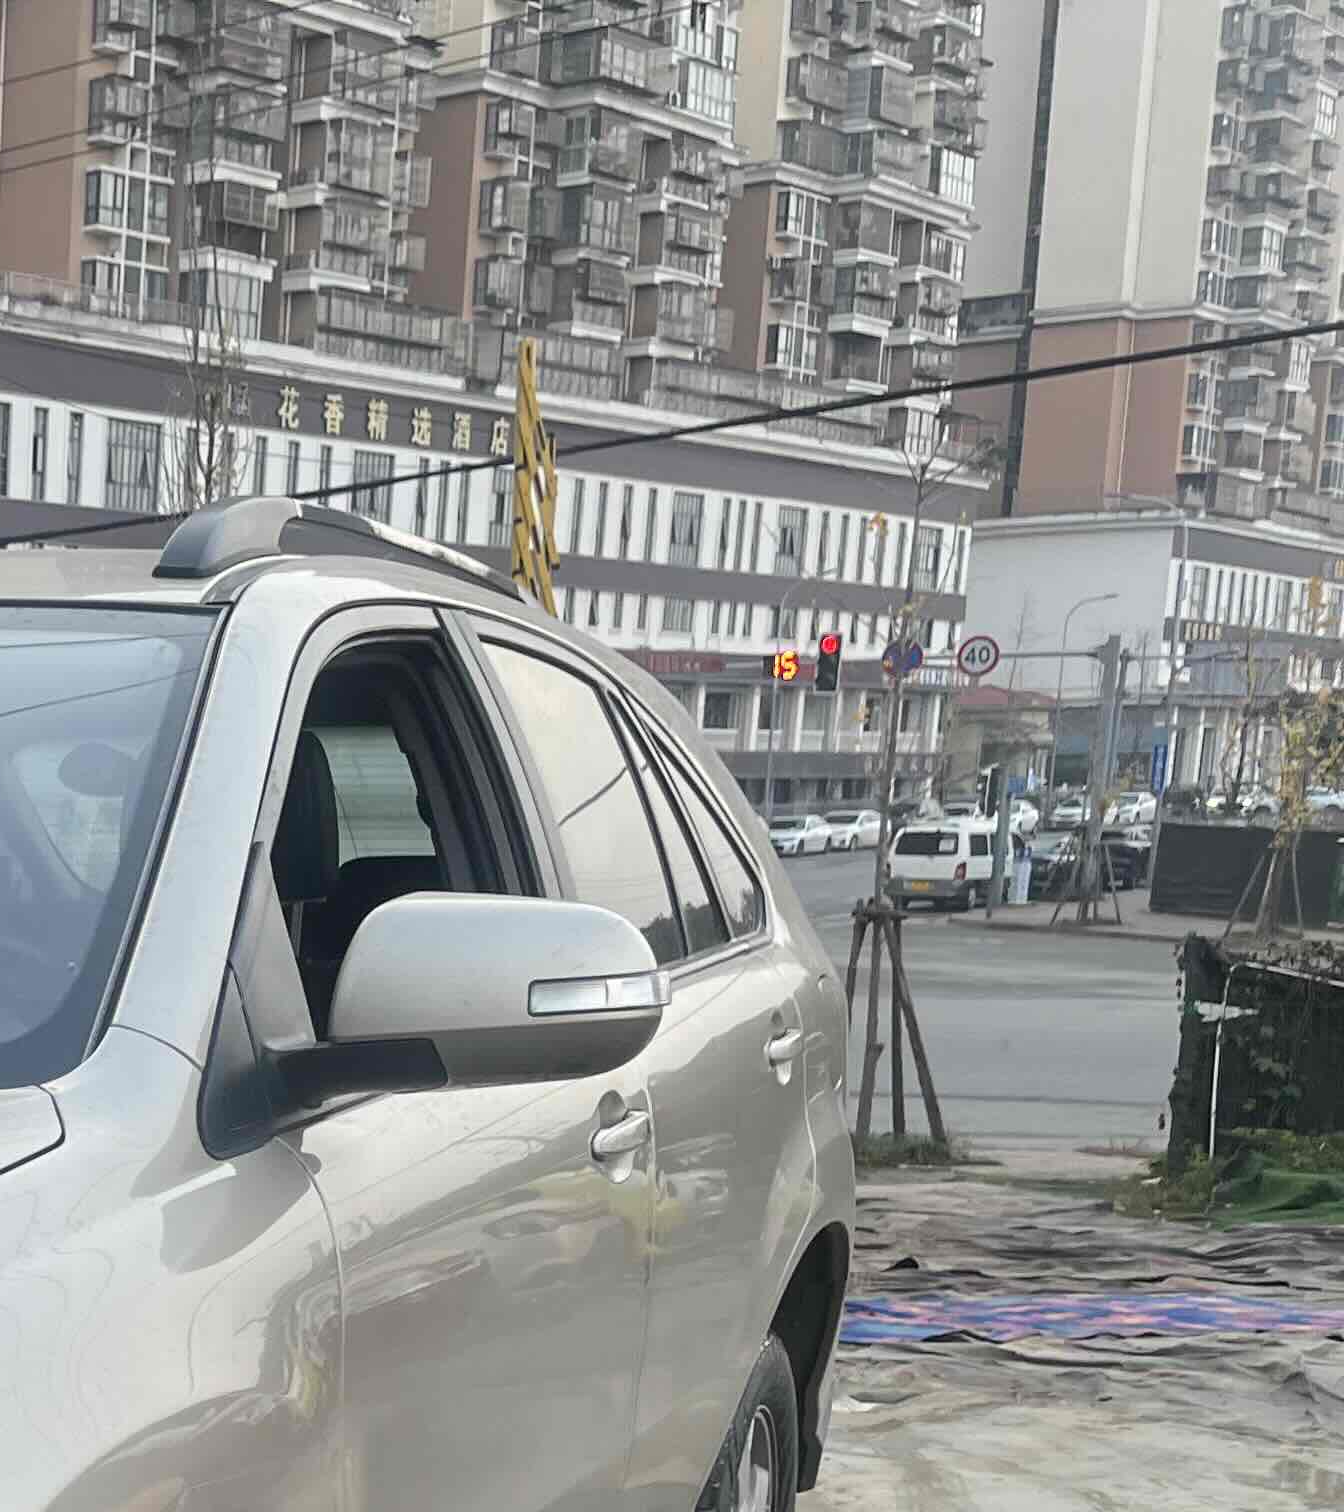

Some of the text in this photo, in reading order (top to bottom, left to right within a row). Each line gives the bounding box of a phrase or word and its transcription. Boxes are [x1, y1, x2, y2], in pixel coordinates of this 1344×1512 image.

[277, 384, 511, 457] 花香精选酒店
[773, 650, 800, 681] 15
[964, 646, 991, 666] 40
